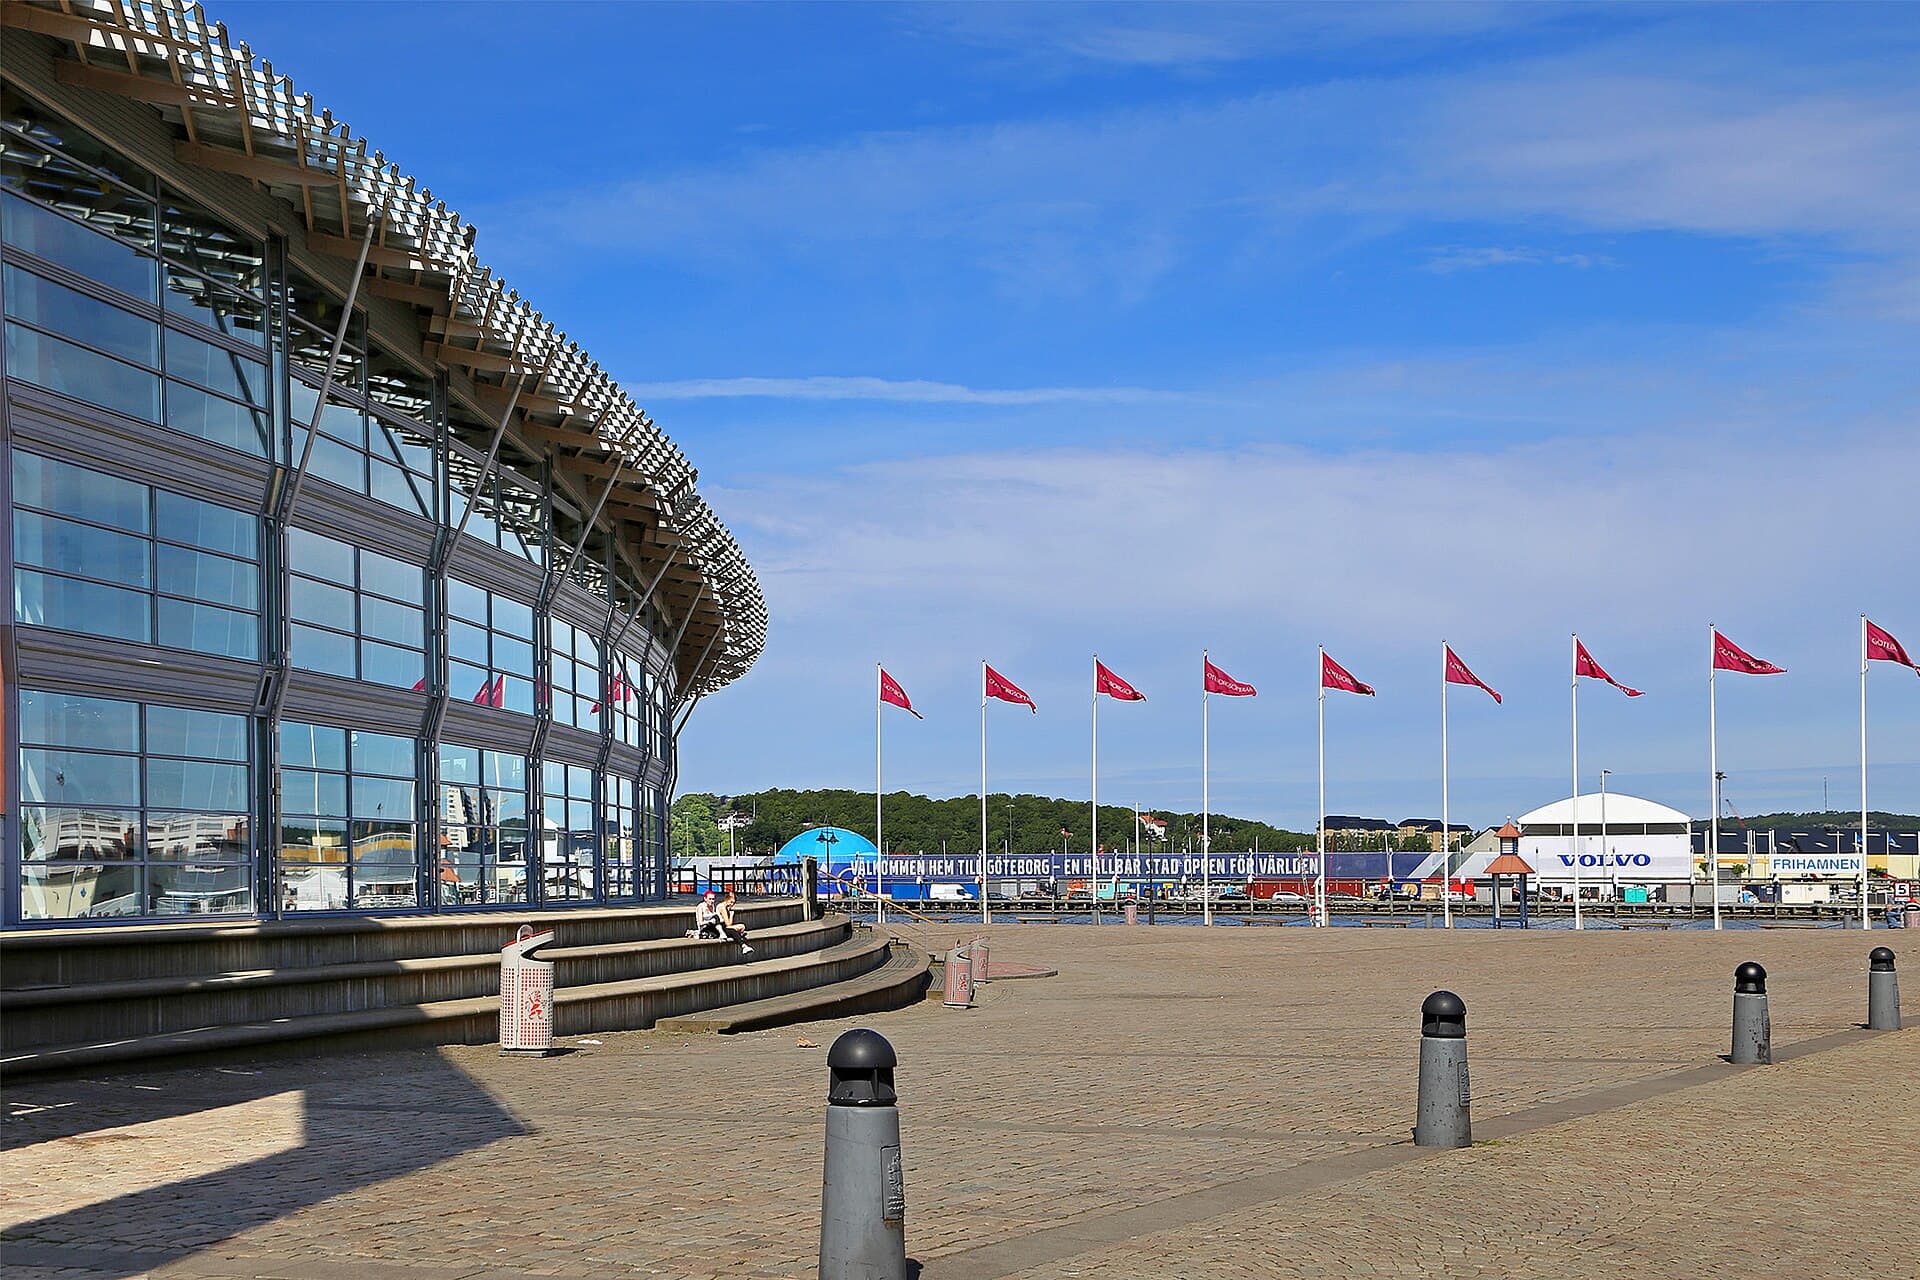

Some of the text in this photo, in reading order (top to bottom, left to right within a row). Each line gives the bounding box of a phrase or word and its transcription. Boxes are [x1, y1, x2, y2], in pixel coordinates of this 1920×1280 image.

[851, 857, 925, 875] VÄLKOMMEN
[929, 859, 954, 875] HEM
[958, 859, 982, 875] TILL
[987, 855, 1050, 875] GÖTEBORG
[1064, 859, 1080, 875] EN
[1145, 858, 1179, 874] STAD
[1230, 855, 1254, 874] FÖR
[1258, 855, 1319, 874] VÄRLDEN
[1557, 854, 1651, 867] VOLVO
[1773, 858, 1860, 870] FRIHAMNEN
[1898, 884, 1906, 895] 5
